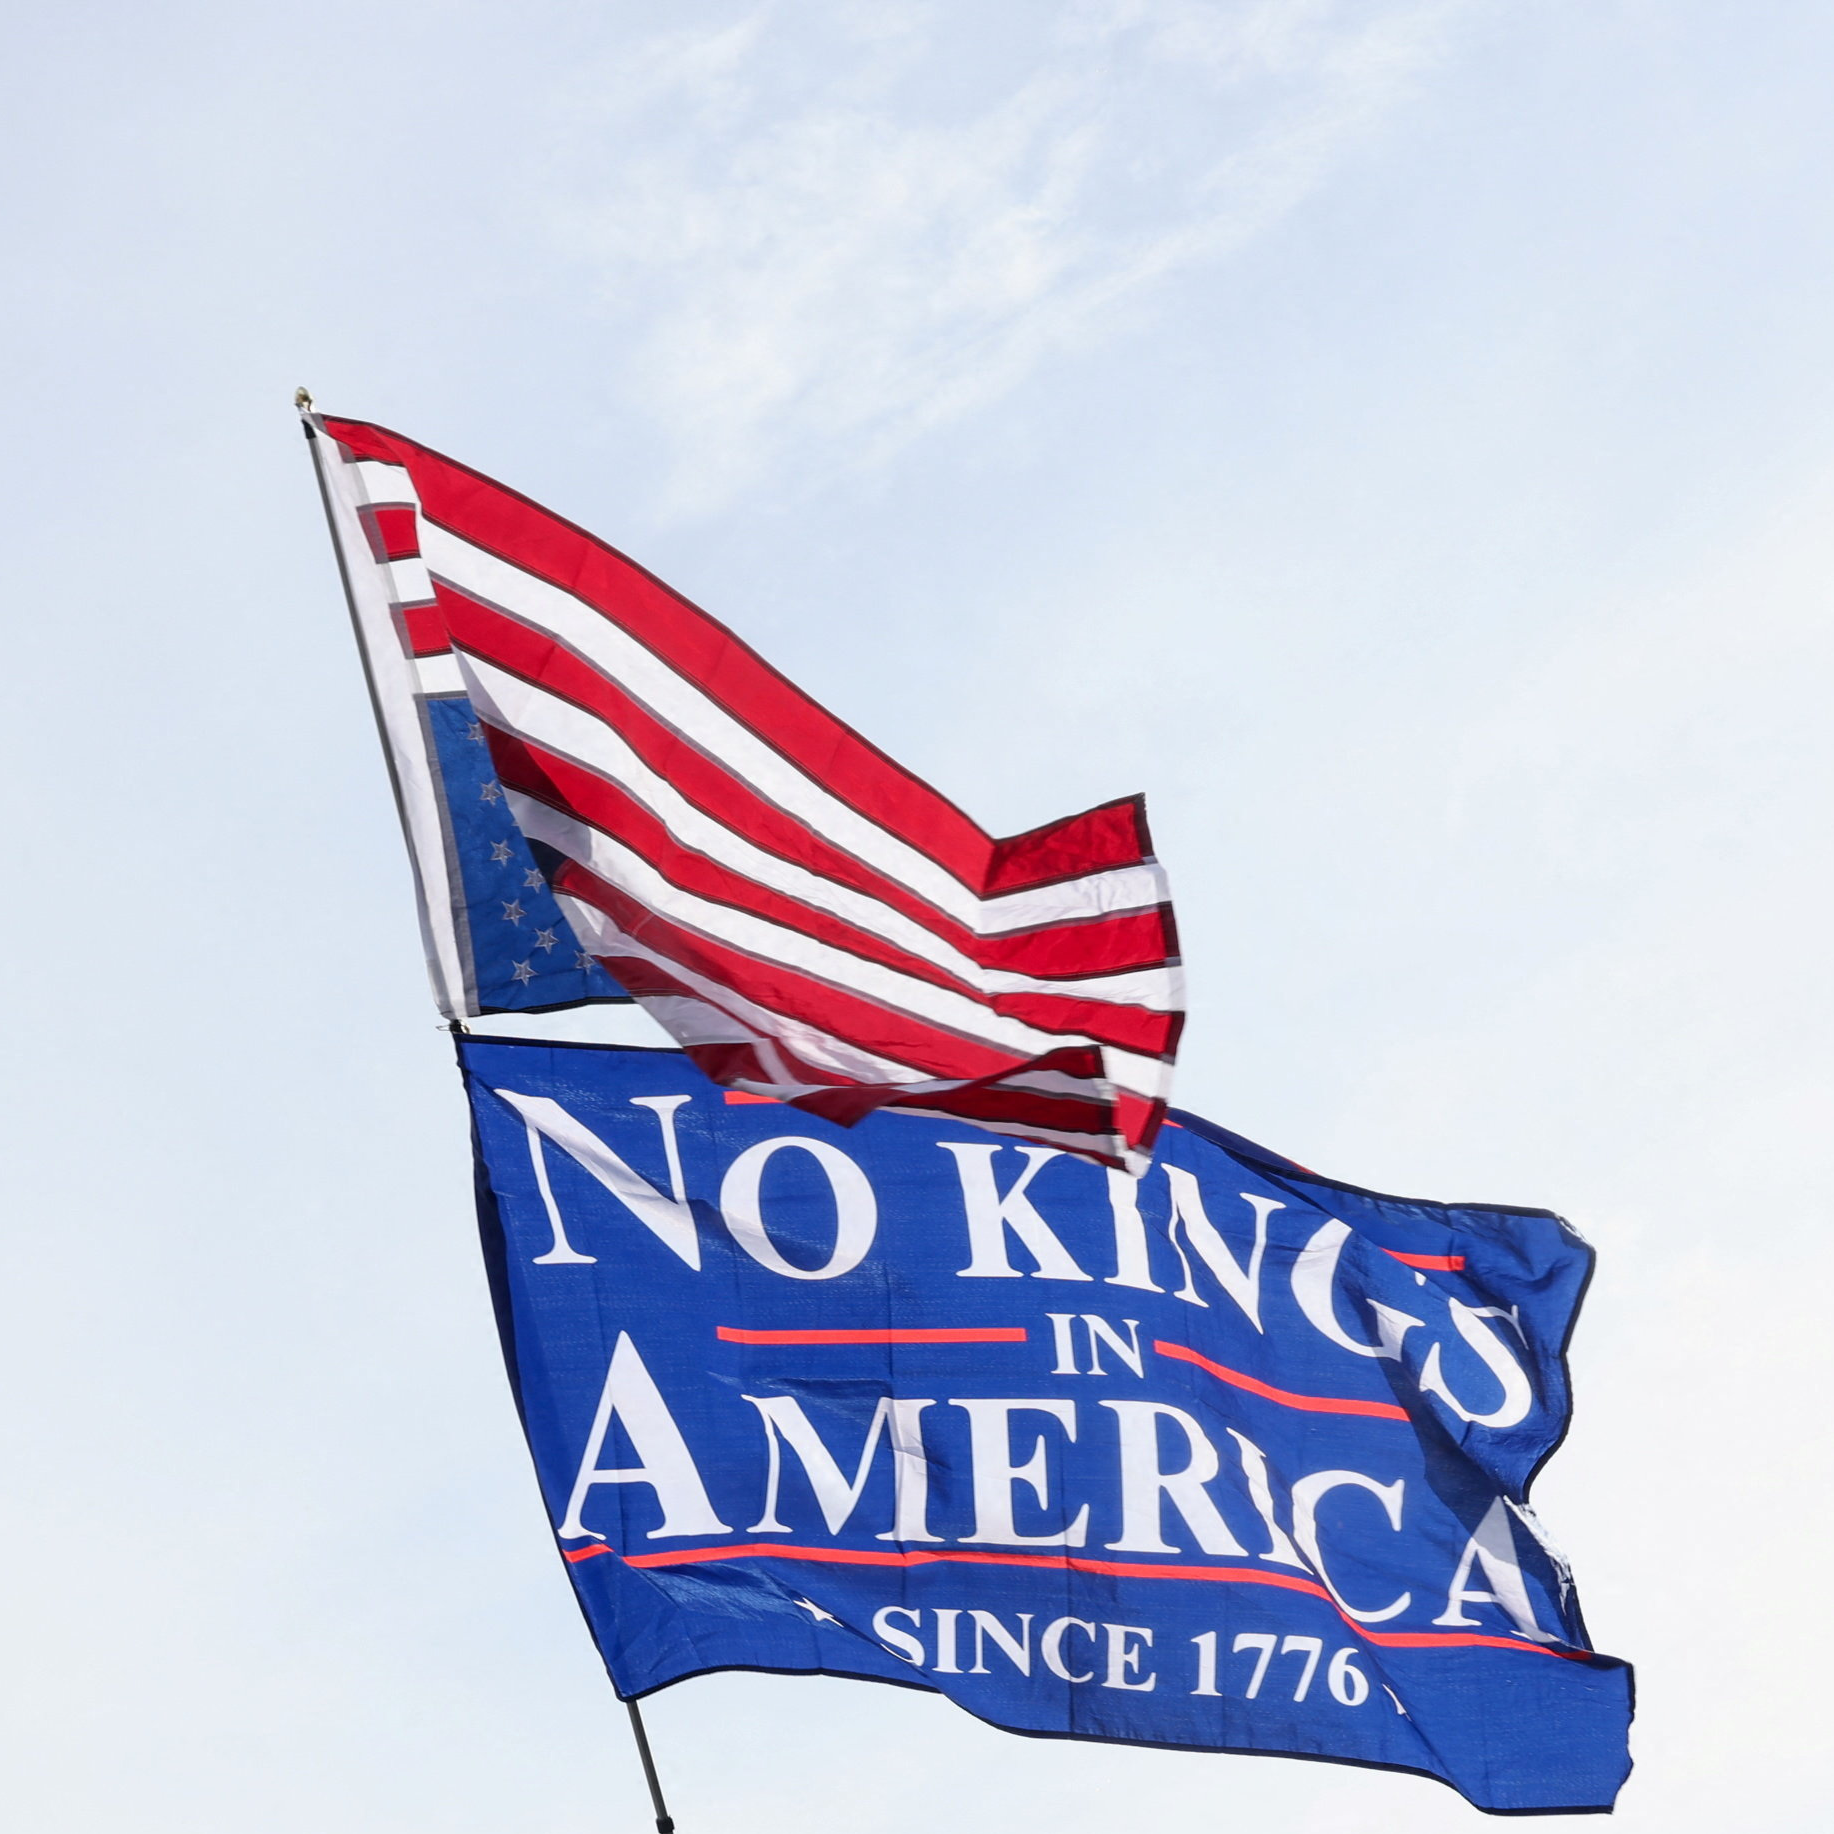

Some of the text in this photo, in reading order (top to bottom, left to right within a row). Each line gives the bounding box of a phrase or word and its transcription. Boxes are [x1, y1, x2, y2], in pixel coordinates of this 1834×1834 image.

[936, 1140, 1533, 1428] KINGS
[1049, 1312, 1144, 1382] IN
[558, 1330, 1562, 1643] AMERICA
[871, 1604, 1369, 1708] SINCE 1776
